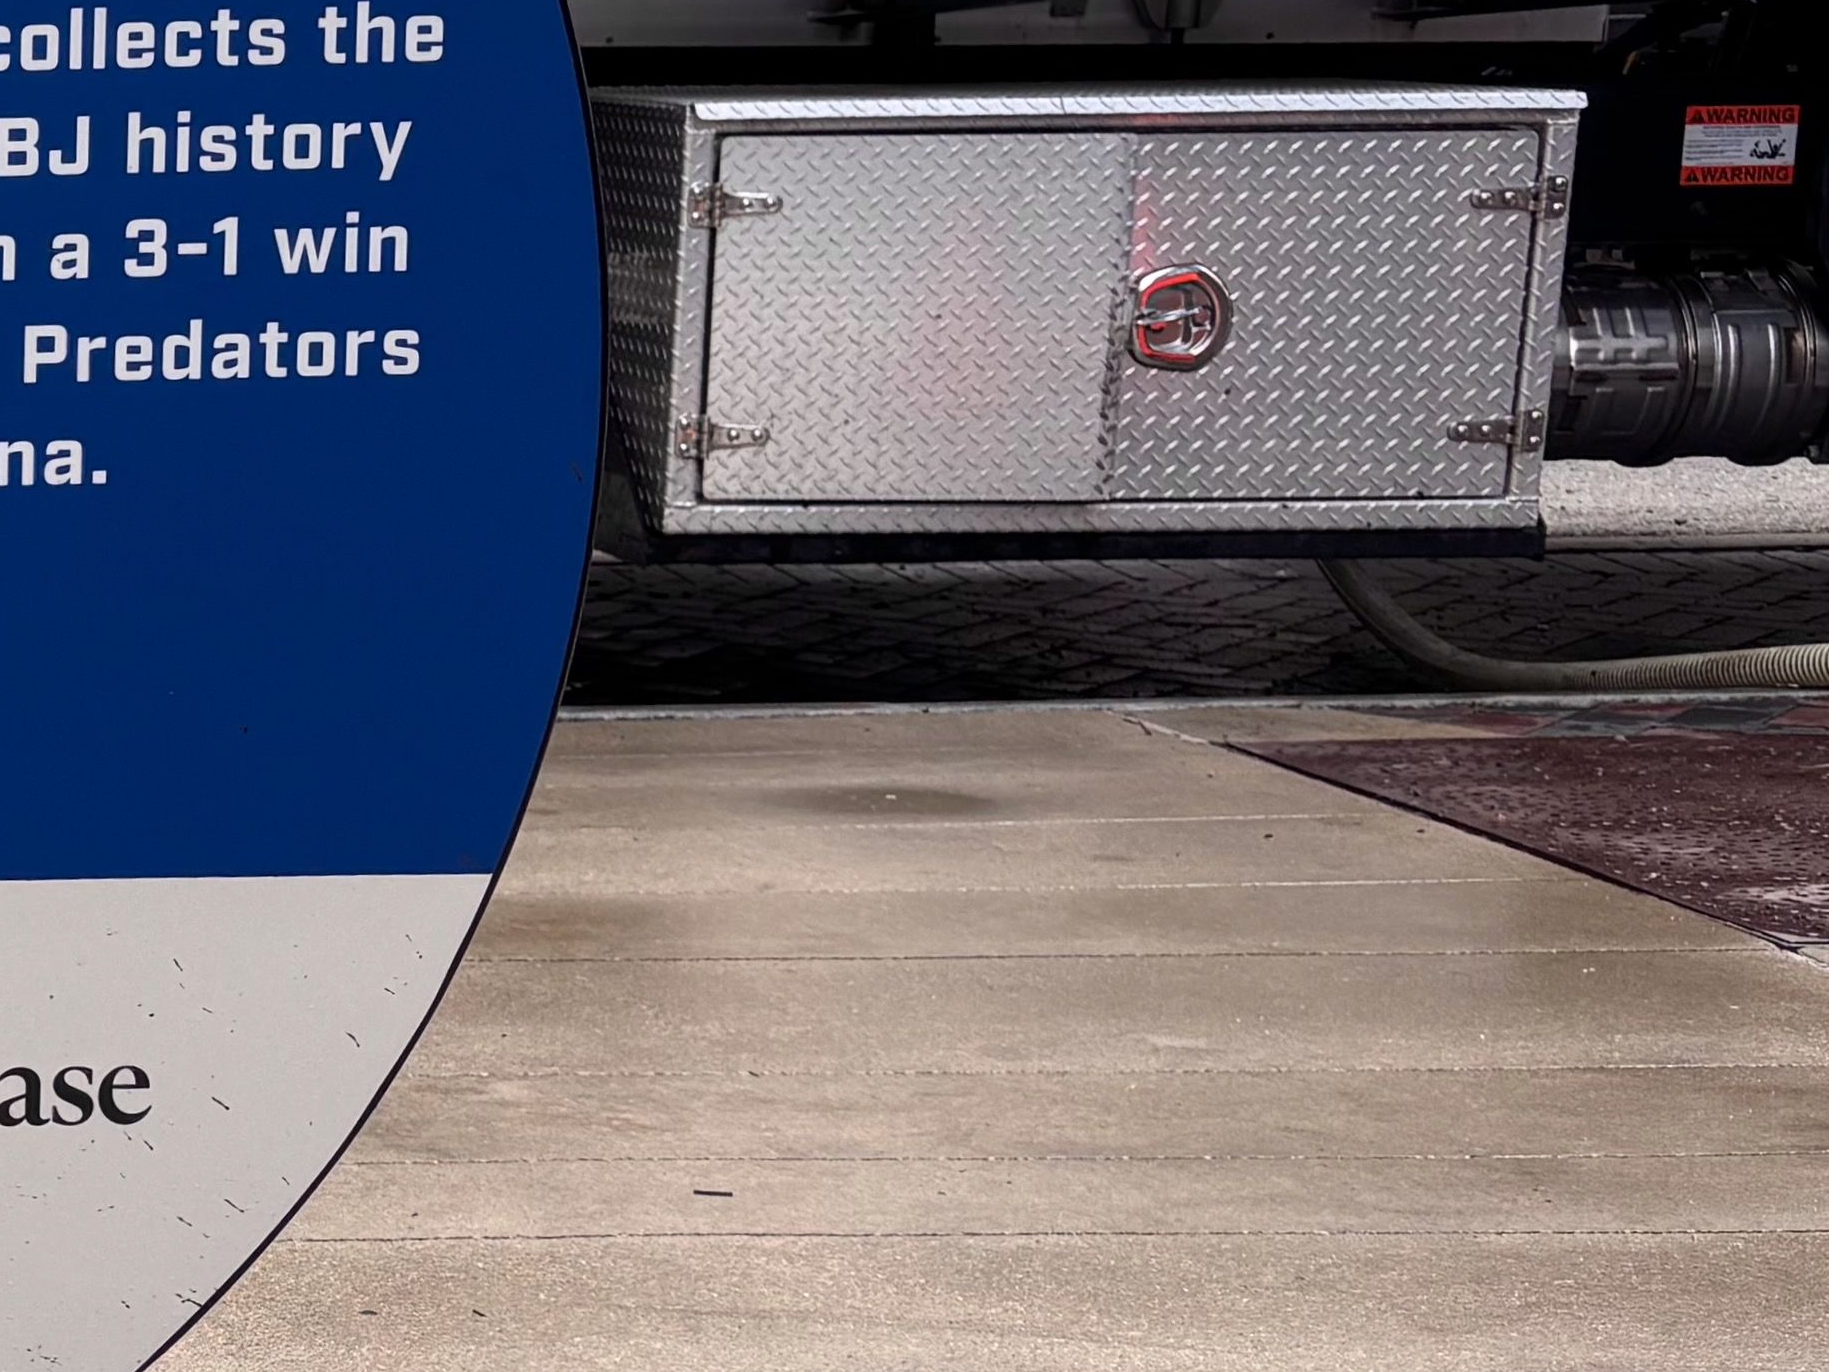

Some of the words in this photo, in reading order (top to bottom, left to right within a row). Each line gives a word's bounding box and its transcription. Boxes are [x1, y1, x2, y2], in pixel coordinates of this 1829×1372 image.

[319, 1, 444, 63] the
[127, 111, 412, 181] history
[1706, 107, 1795, 124] WARNING
[1702, 167, 1789, 182] WARNING
[51, 234, 90, 280] a
[125, 217, 239, 278] 3-1
[275, 212, 408, 274] win
[24, 319, 420, 384] Predators
